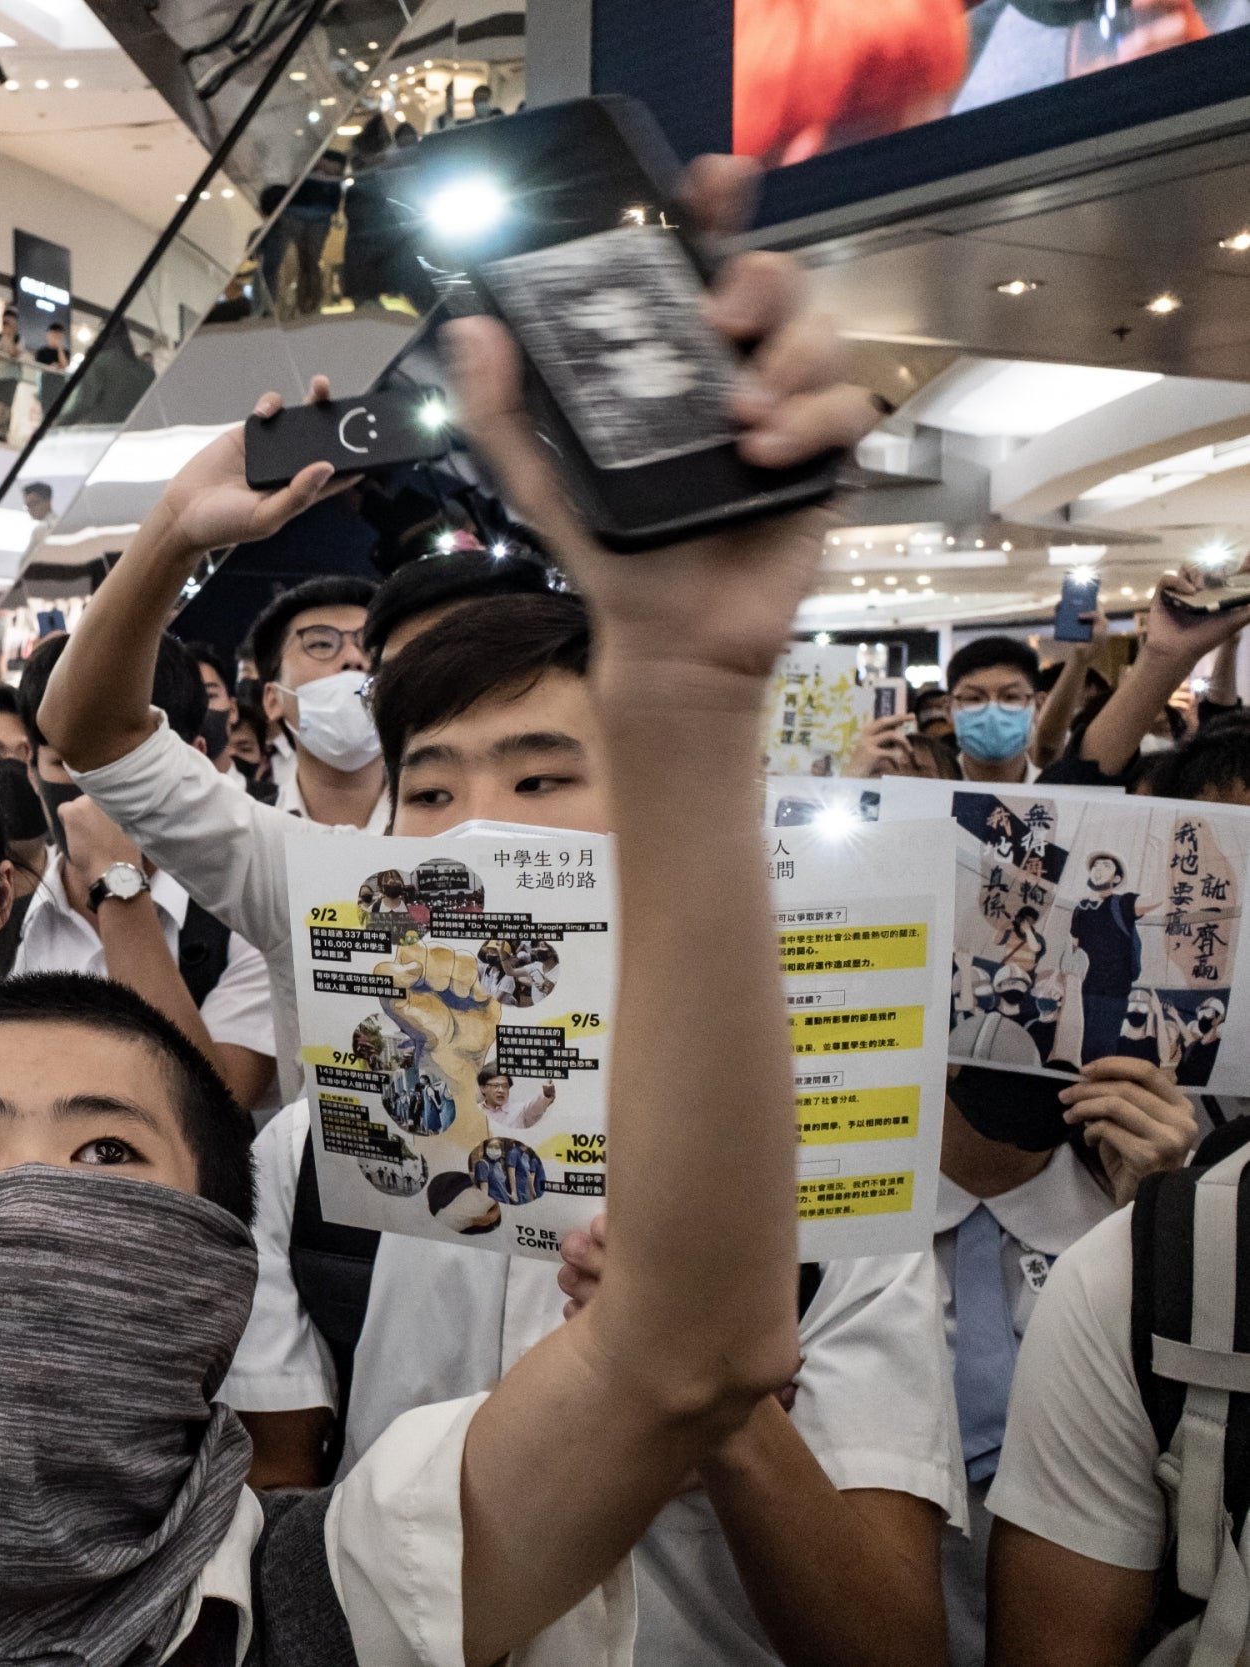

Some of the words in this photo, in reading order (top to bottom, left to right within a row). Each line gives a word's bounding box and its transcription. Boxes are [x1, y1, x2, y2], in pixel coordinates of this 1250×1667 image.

[494, 849, 551, 868] 中學生
[559, 851, 570, 867] 9
[577, 849, 593, 867] 月
[516, 871, 596, 890] 走過的路
[311, 908, 337, 921] 9/2
[774, 911, 842, 923] 可以爭取訴求？
[344, 931, 361, 939] 337
[323, 940, 353, 949] 16,000
[571, 1014, 600, 1028] 9/5
[791, 1038, 900, 1053] 後果，並尊重學生的決定。
[333, 1051, 358, 1065] 9/9
[319, 1066, 334, 1076] 143
[572, 1134, 607, 1148] 10/9
[566, 1149, 606, 1164] NOW
[515, 1225, 535, 1237] TO
[539, 1229, 558, 1241] BE
